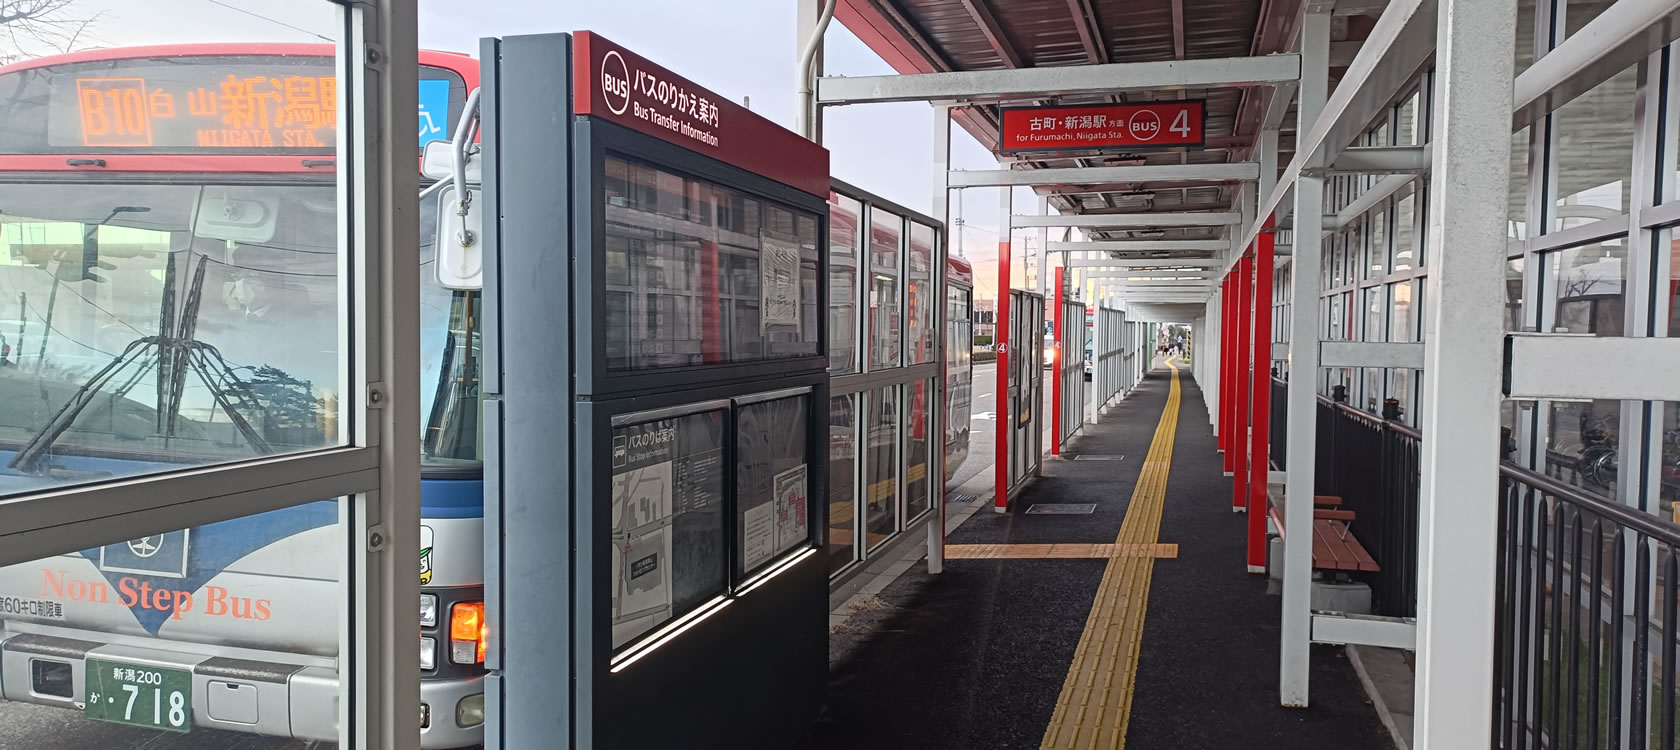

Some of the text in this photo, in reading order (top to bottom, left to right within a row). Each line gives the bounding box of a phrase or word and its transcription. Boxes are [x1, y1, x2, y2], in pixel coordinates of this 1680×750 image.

[604, 73, 627, 99] BUS
[634, 68, 719, 128] バスのりかえ案内
[82, 88, 145, 135] B10
[634, 101, 719, 148] Bus Transfer Information
[1029, 114, 1124, 131] 古町・新潟駅 方面
[1132, 122, 1157, 132] BUS
[1169, 109, 1191, 138] 4
[198, 129, 325, 147] NIIGATA STA.
[1016, 133, 1029, 142] for
[1076, 131, 1107, 141] Niigata
[1108, 130, 1124, 139] Sta.
[628, 428, 675, 449] バスのりば案内
[628, 454, 636, 463] Bus
[41, 568, 272, 622] Non Step Bus
[90, 692, 100, 704] か
